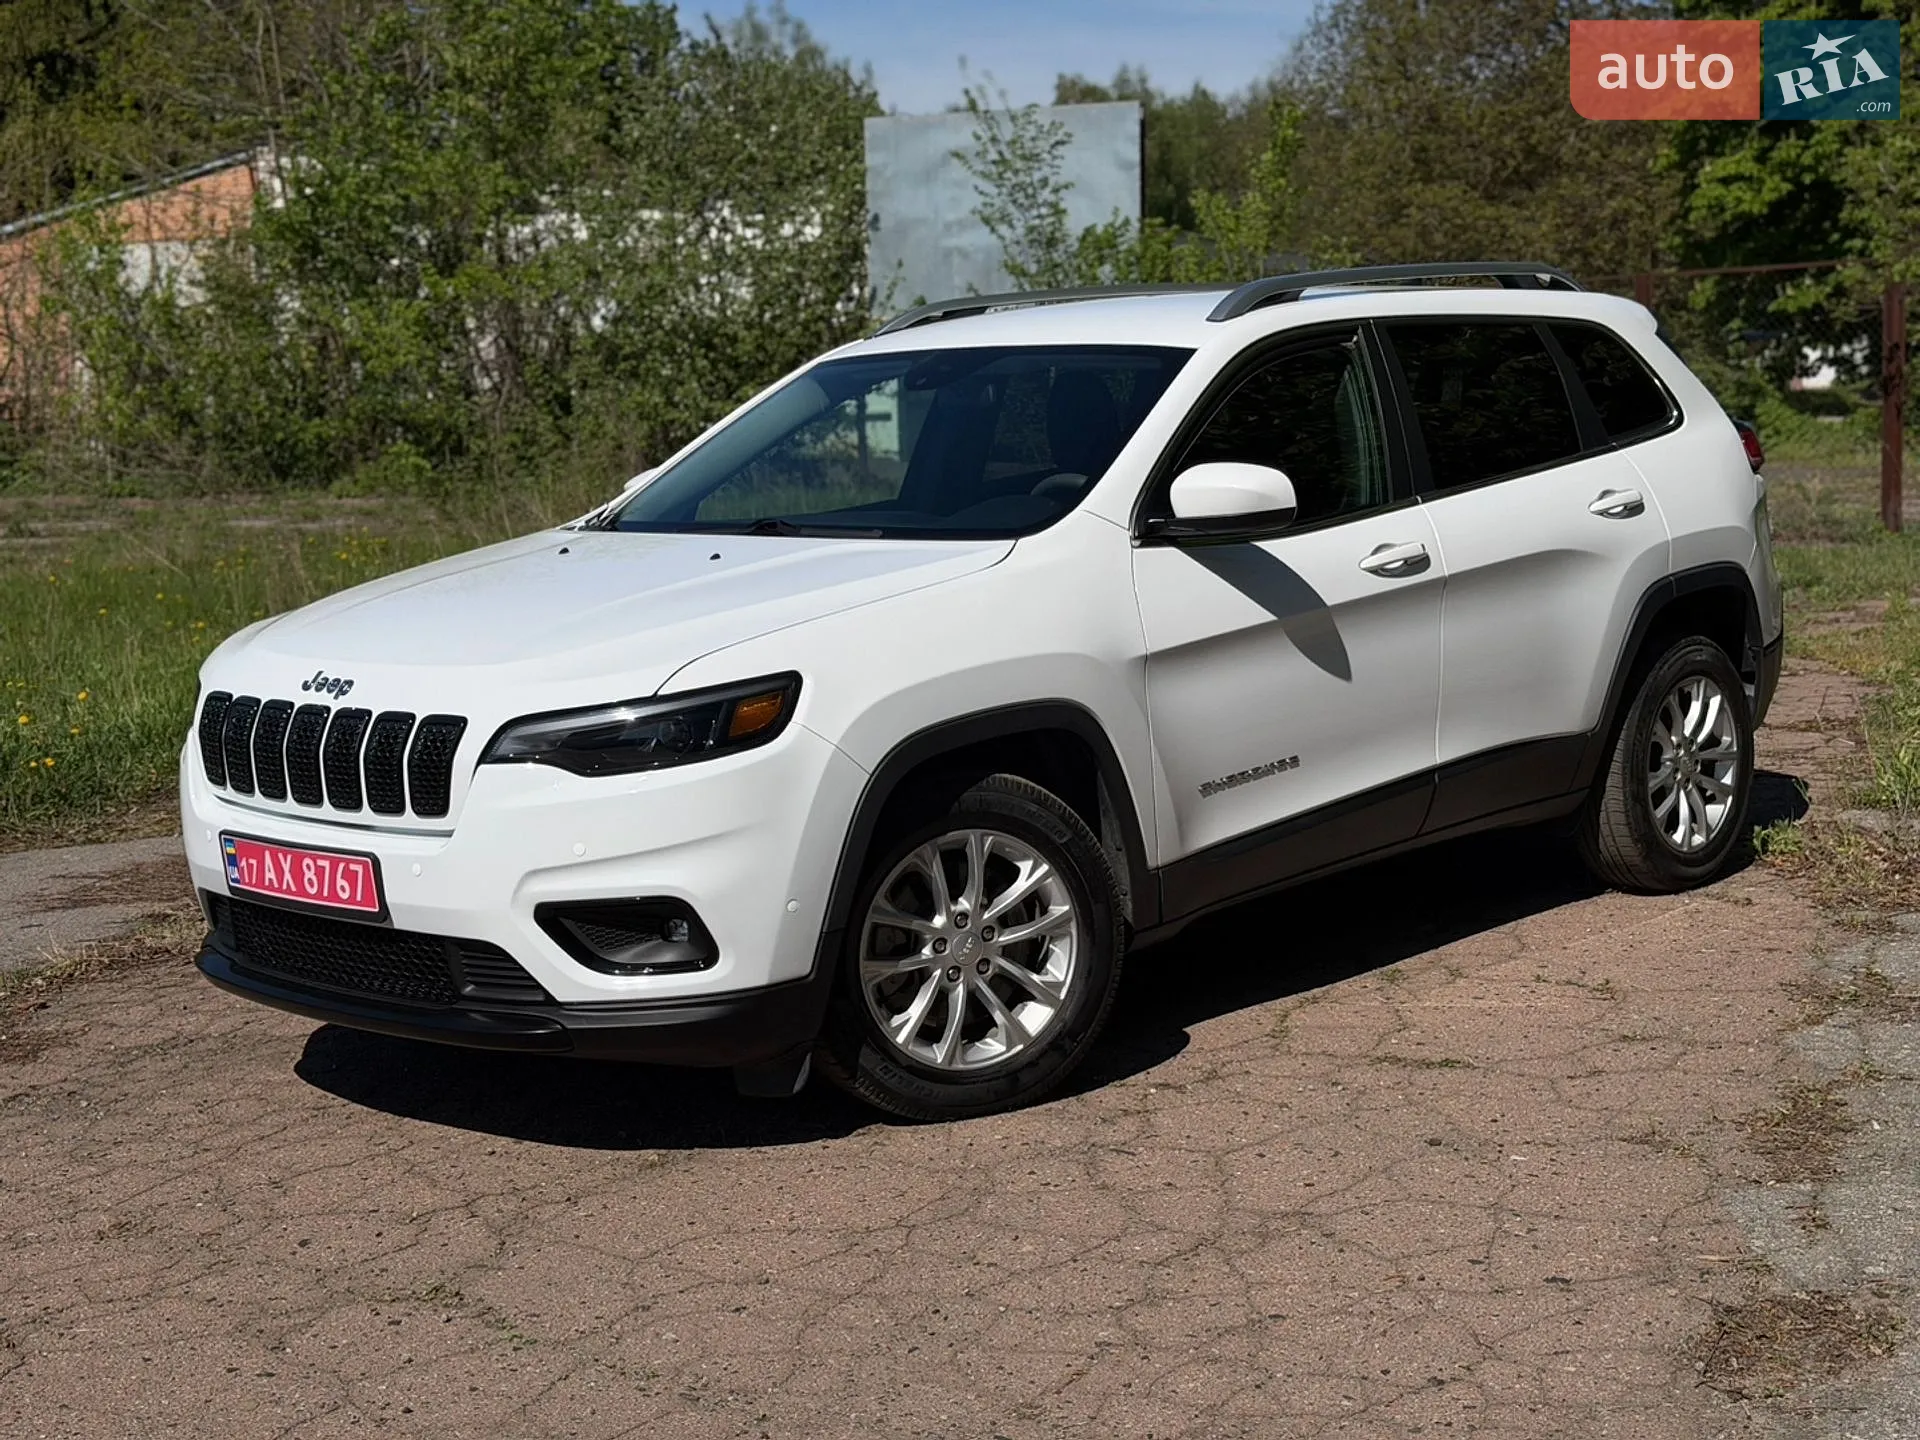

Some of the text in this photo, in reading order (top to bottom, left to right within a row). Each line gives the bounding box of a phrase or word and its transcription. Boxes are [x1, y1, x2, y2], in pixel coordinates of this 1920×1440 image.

[301, 670, 355, 700] Jeep
[229, 865, 240, 879] UA
[239, 850, 364, 902] 17 AX 8767
